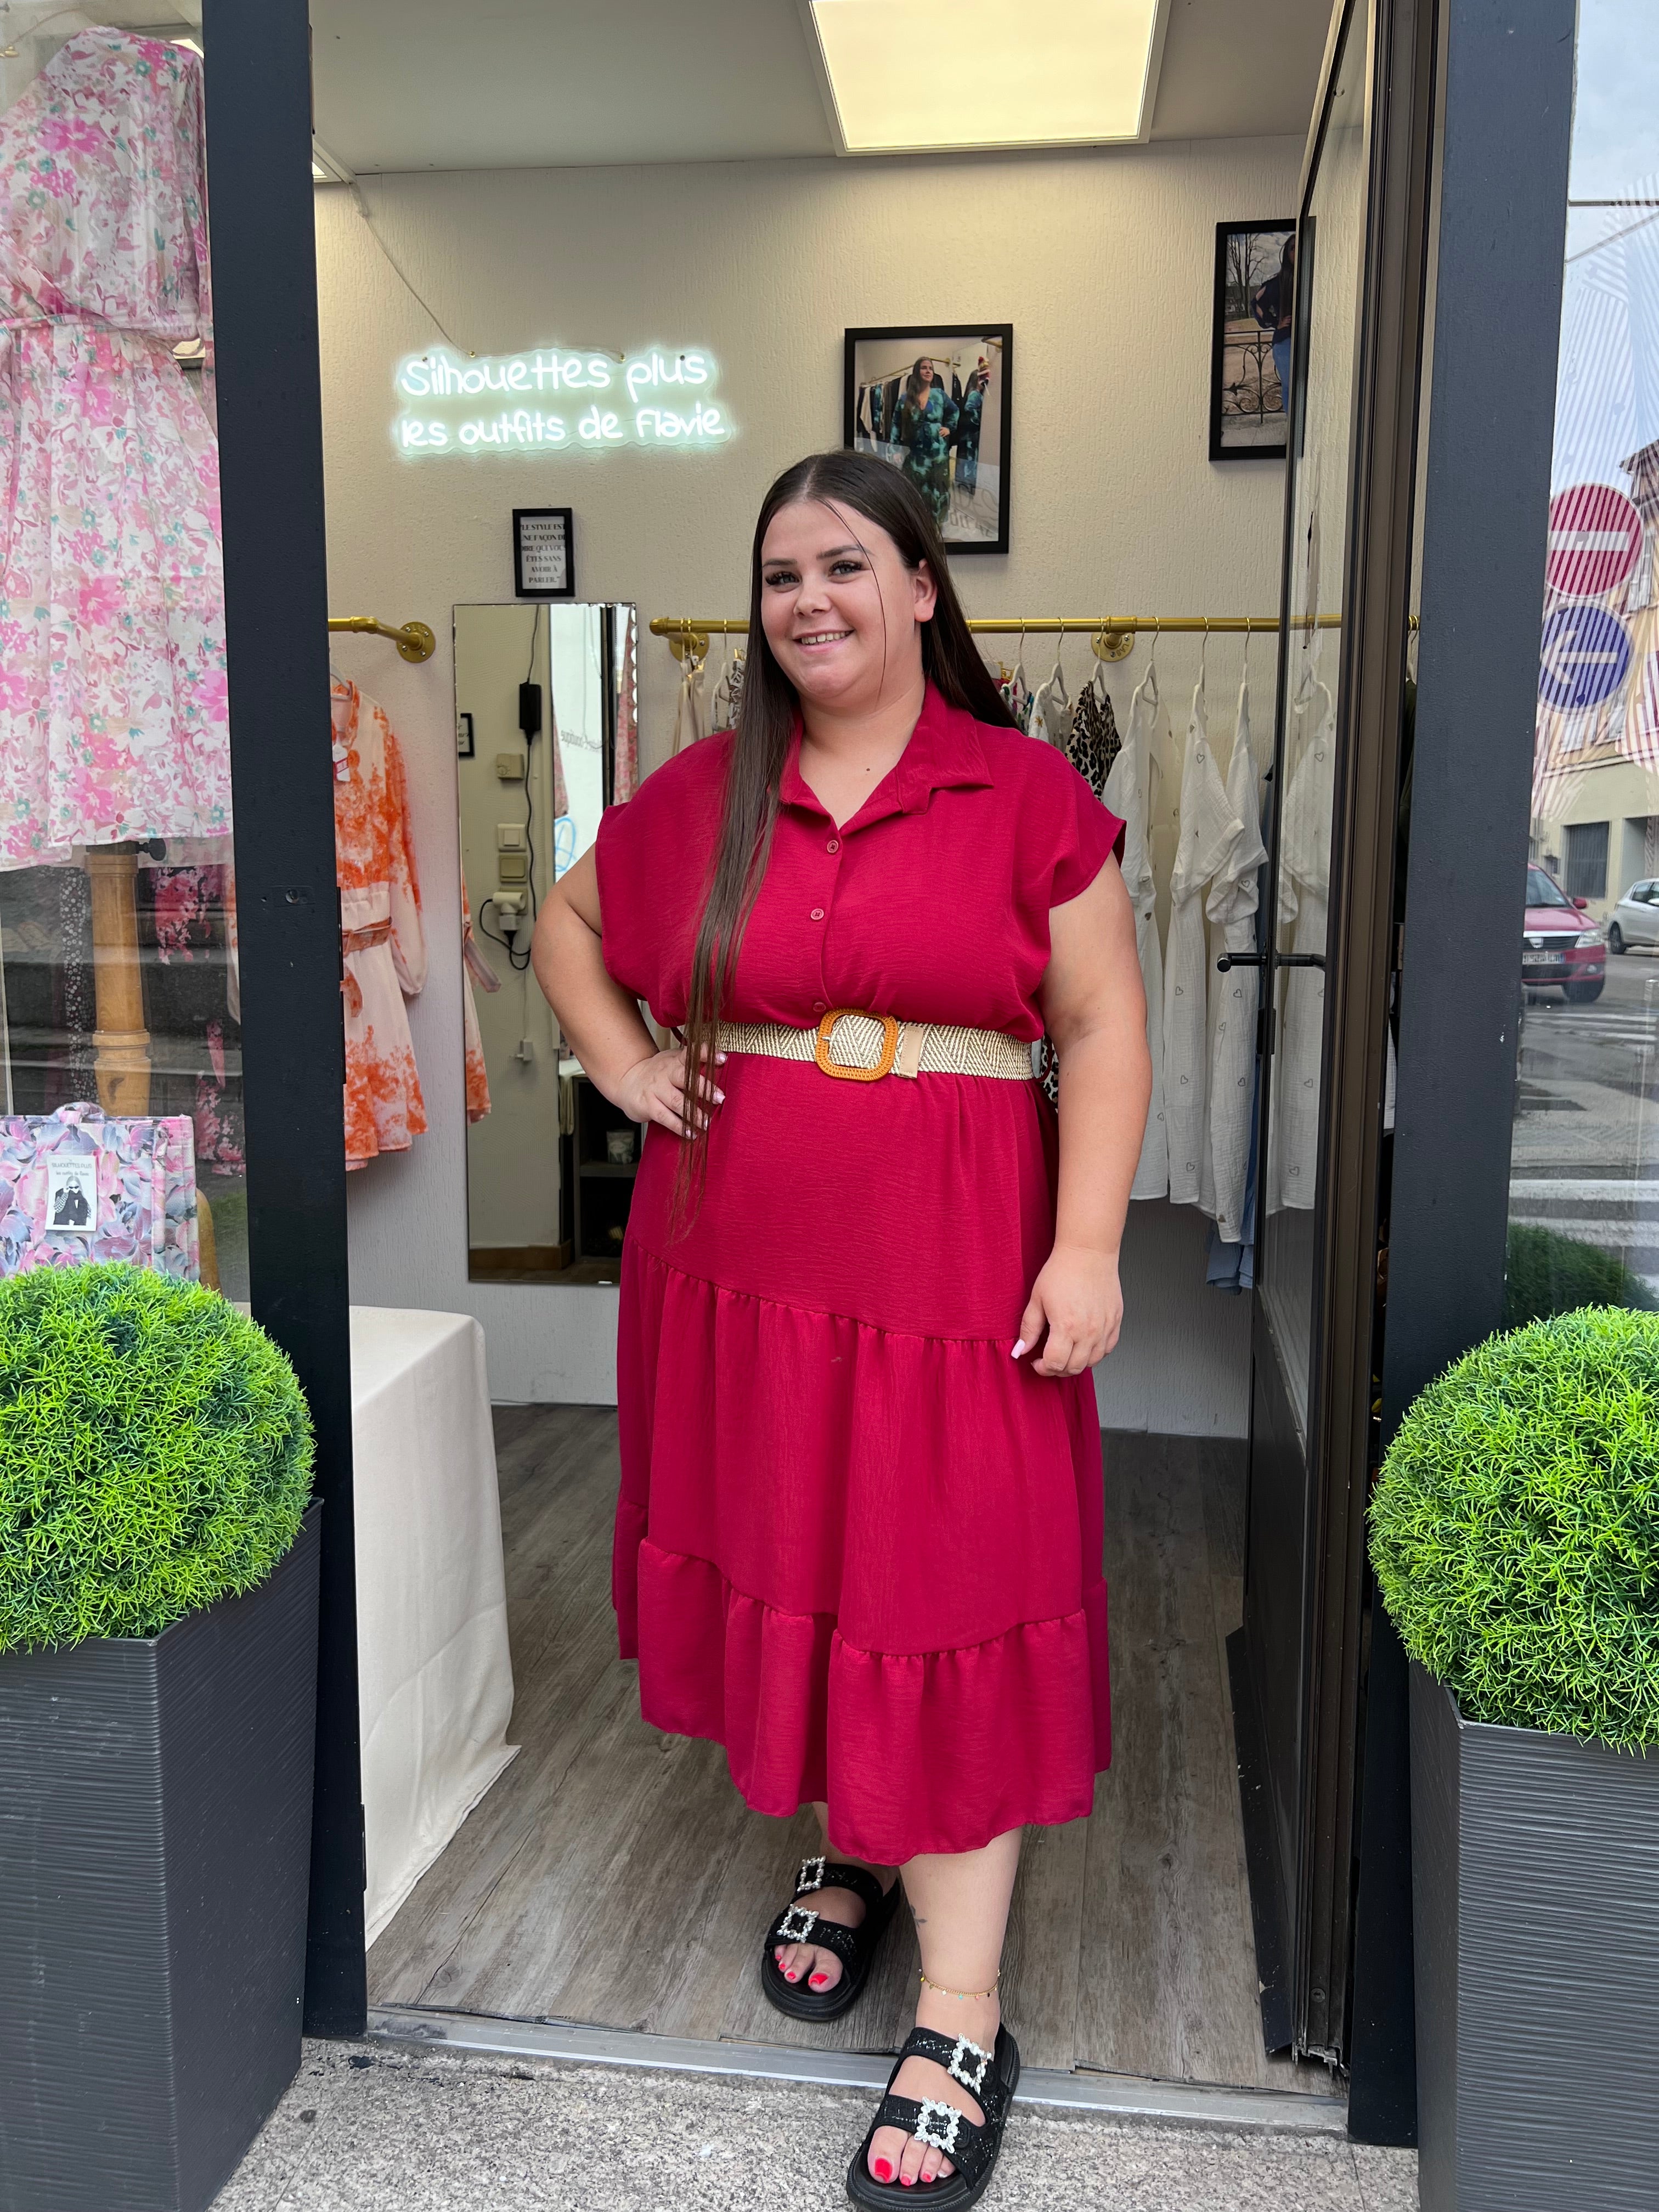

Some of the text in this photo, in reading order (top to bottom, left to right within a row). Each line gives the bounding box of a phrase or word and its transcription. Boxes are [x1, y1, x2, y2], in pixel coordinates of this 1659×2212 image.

[401, 354, 708, 402] Silhouettes plus
[459, 409, 566, 445] outfits
[579, 405, 623, 440] de
